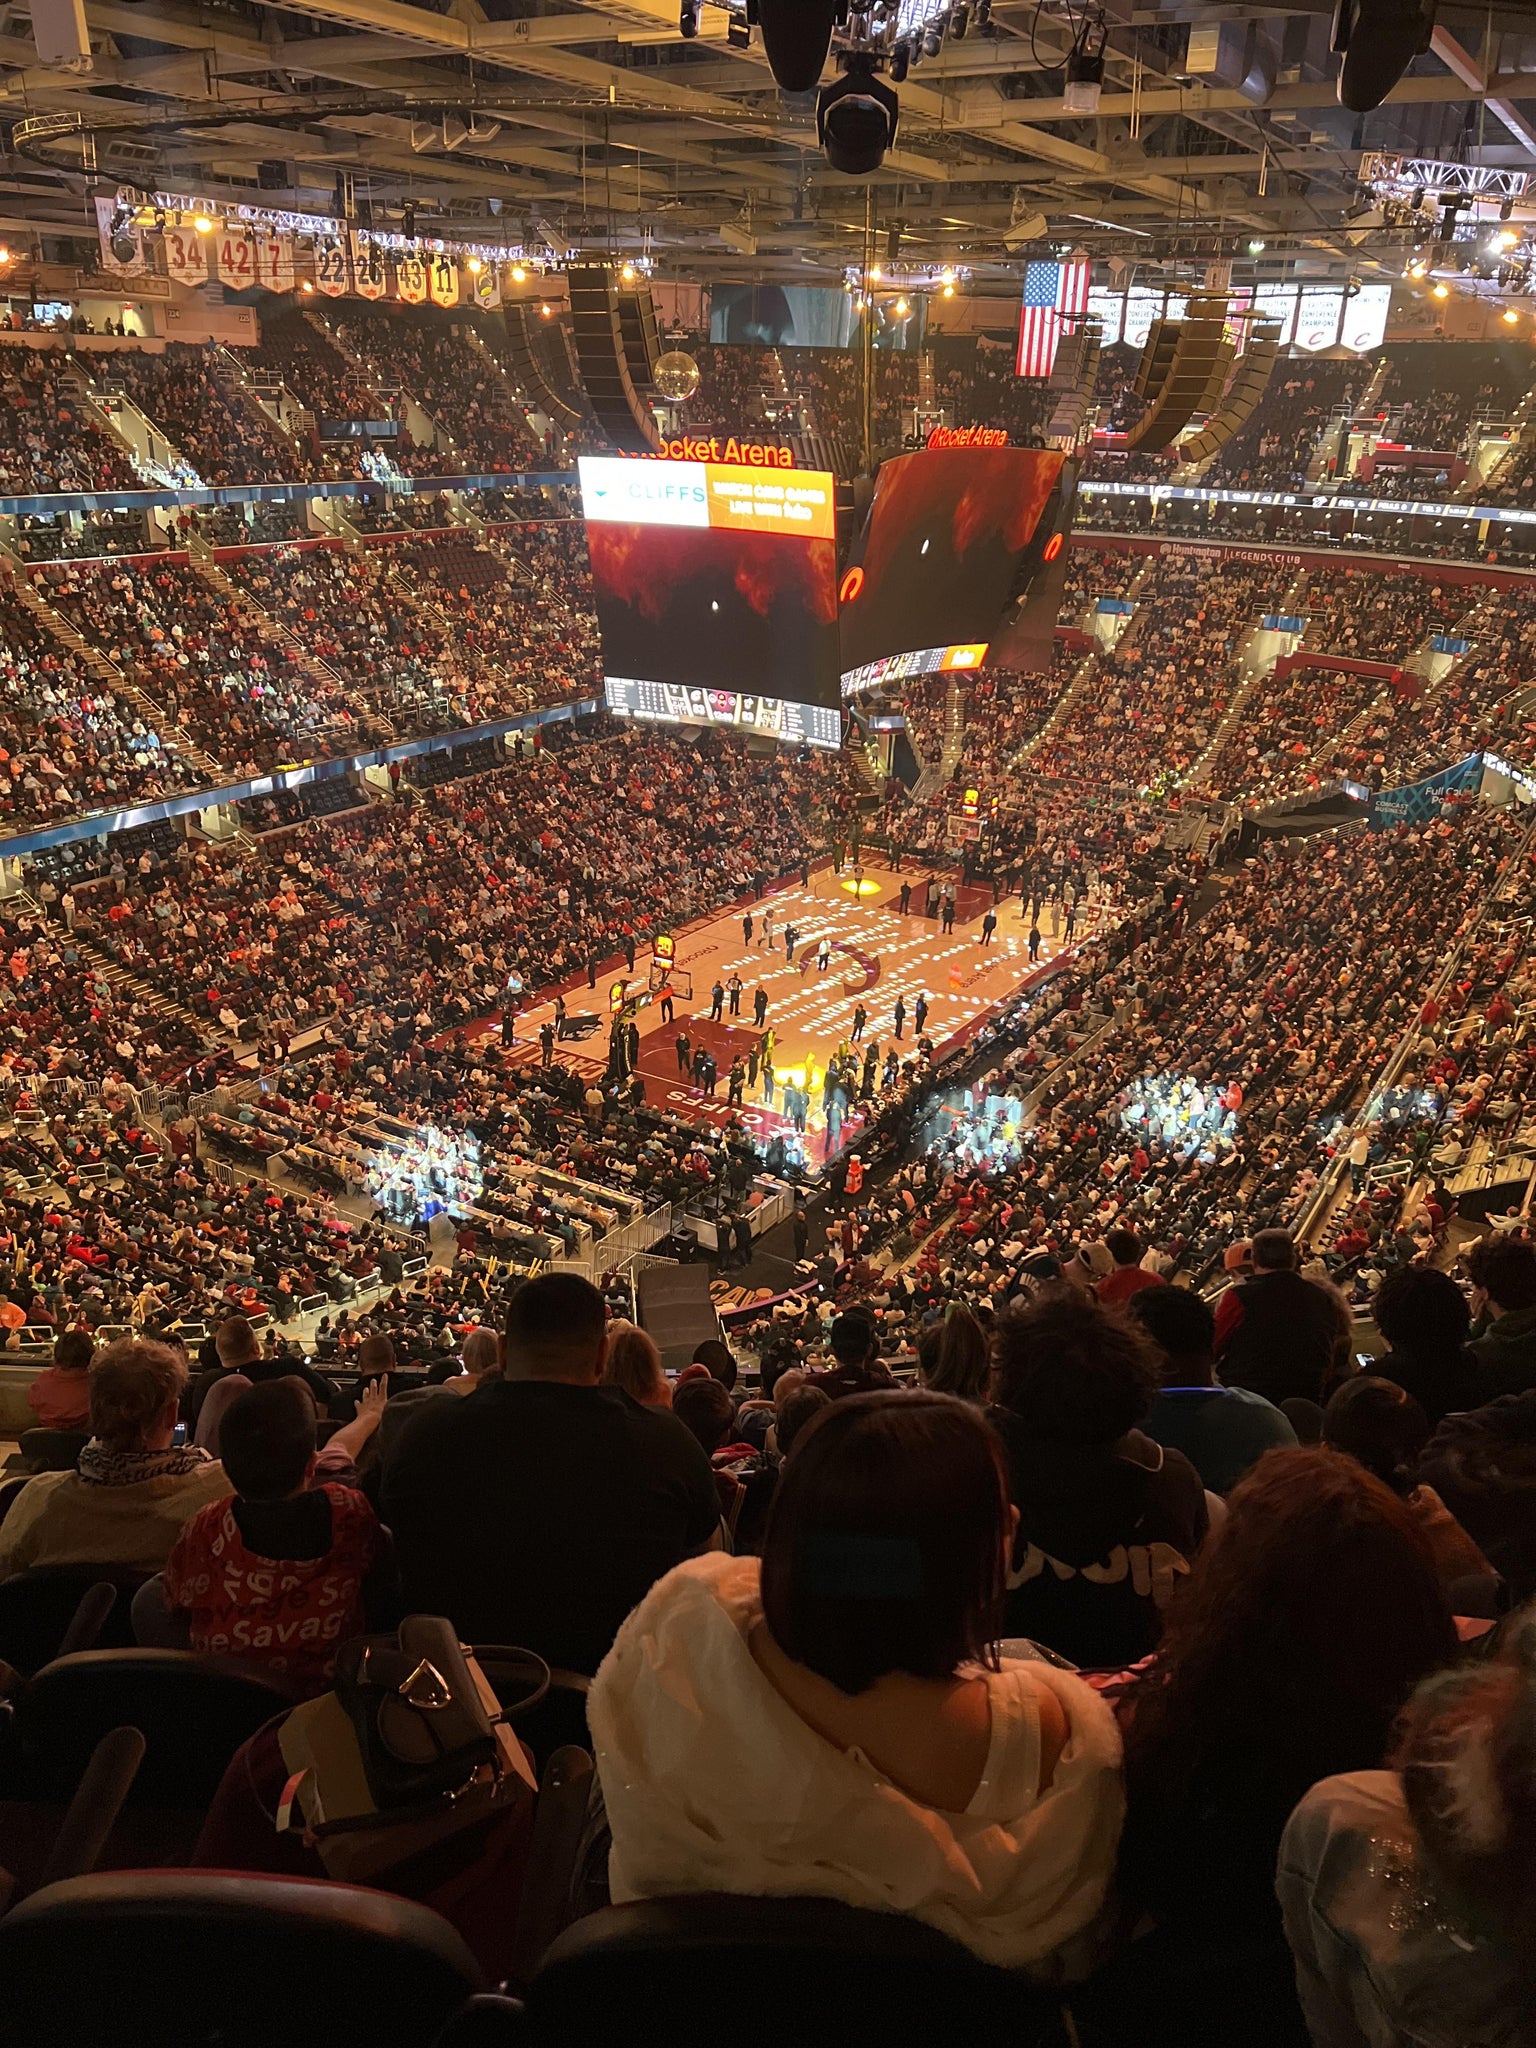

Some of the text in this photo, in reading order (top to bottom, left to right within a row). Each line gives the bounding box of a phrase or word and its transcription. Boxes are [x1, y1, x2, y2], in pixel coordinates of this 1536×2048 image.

[515, 22, 528, 35] 40
[172, 236, 203, 269] 34
[221, 240, 251, 274] 42
[268, 245, 280, 277] 7
[319, 252, 345, 282] 22
[400, 260, 422, 290] 43
[437, 261, 454, 293] 11
[940, 425, 1008, 447] Rocket Arena
[642, 436, 795, 467] ocket Arena
[629, 482, 705, 502] CLIFFS
[1230, 551, 1273, 562] LEGENDS
[1275, 554, 1301, 564] CLUB
[1375, 800, 1409, 810] COMCAST
[1425, 786, 1443, 796] Full
[1374, 806, 1408, 816] BUSINESS
[666, 1090, 764, 1124] CLIFFS
[710, 1280, 759, 1308] CAV
[232, 1608, 346, 1649] Savag
